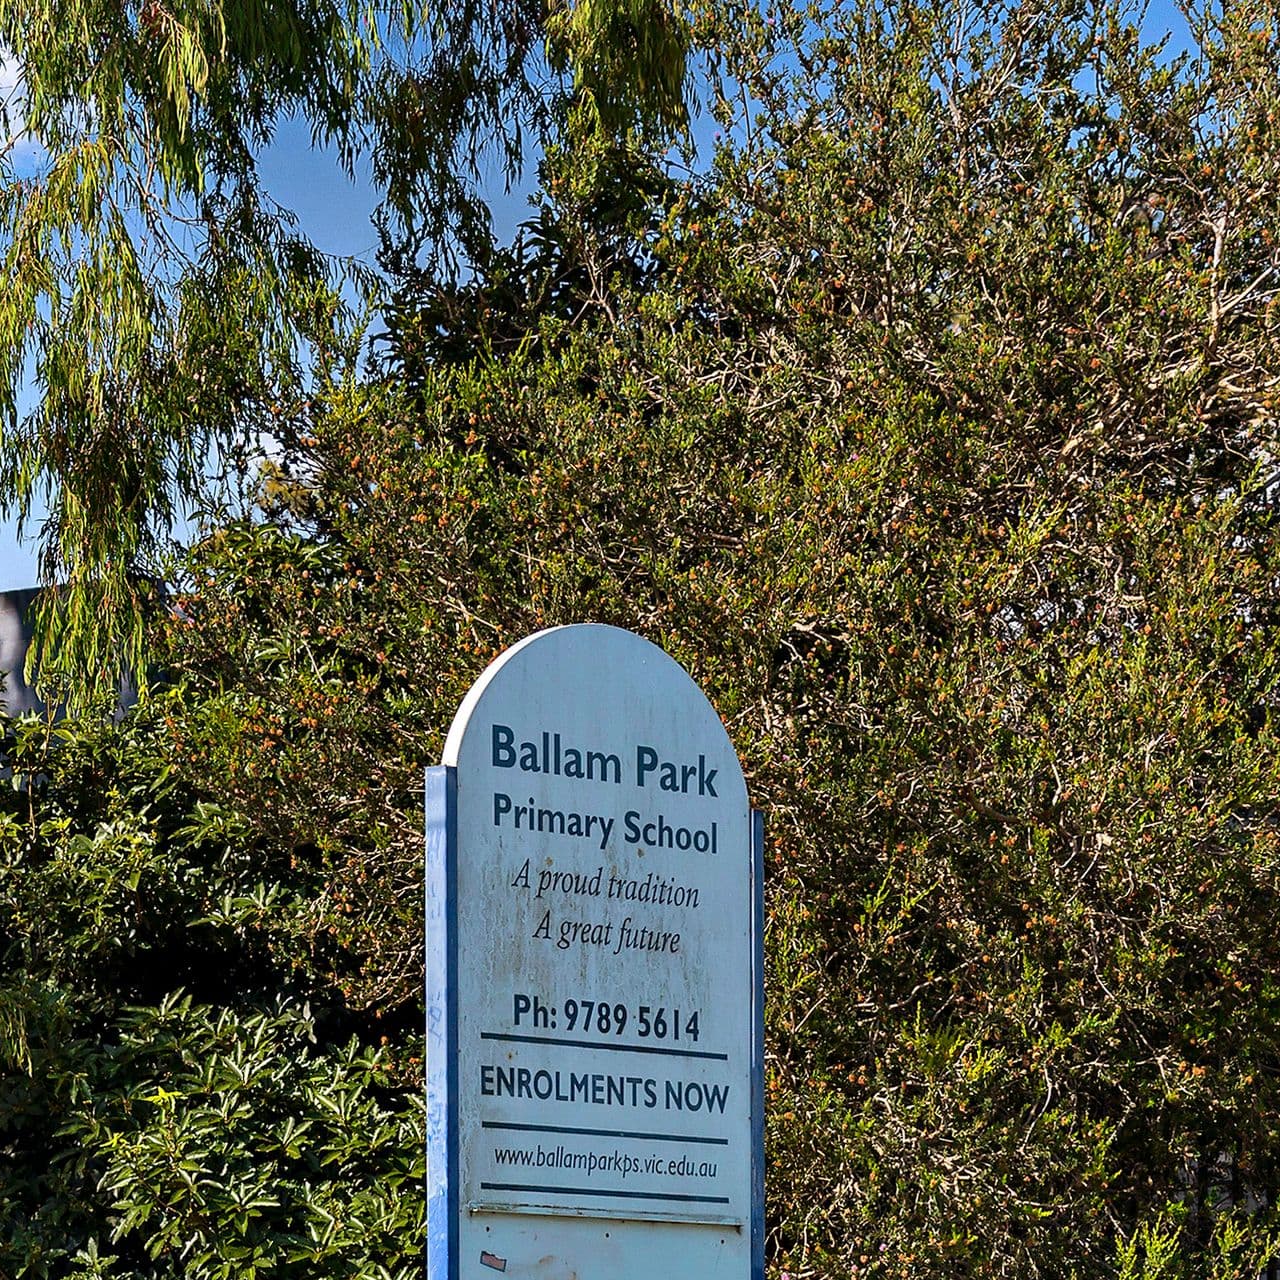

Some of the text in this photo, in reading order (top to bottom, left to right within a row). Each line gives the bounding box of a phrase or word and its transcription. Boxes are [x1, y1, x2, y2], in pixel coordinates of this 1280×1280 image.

[491, 723, 719, 798] Ballam Park
[493, 792, 718, 855] Primary School
[510, 857, 701, 909] A proud tradition
[531, 909, 681, 956] A great future
[513, 993, 700, 1043] Ph: 9789 5614
[480, 1064, 730, 1115] ENROLMENTS NOW
[494, 1144, 718, 1179] www.ballamparkps.vic.edu.au
